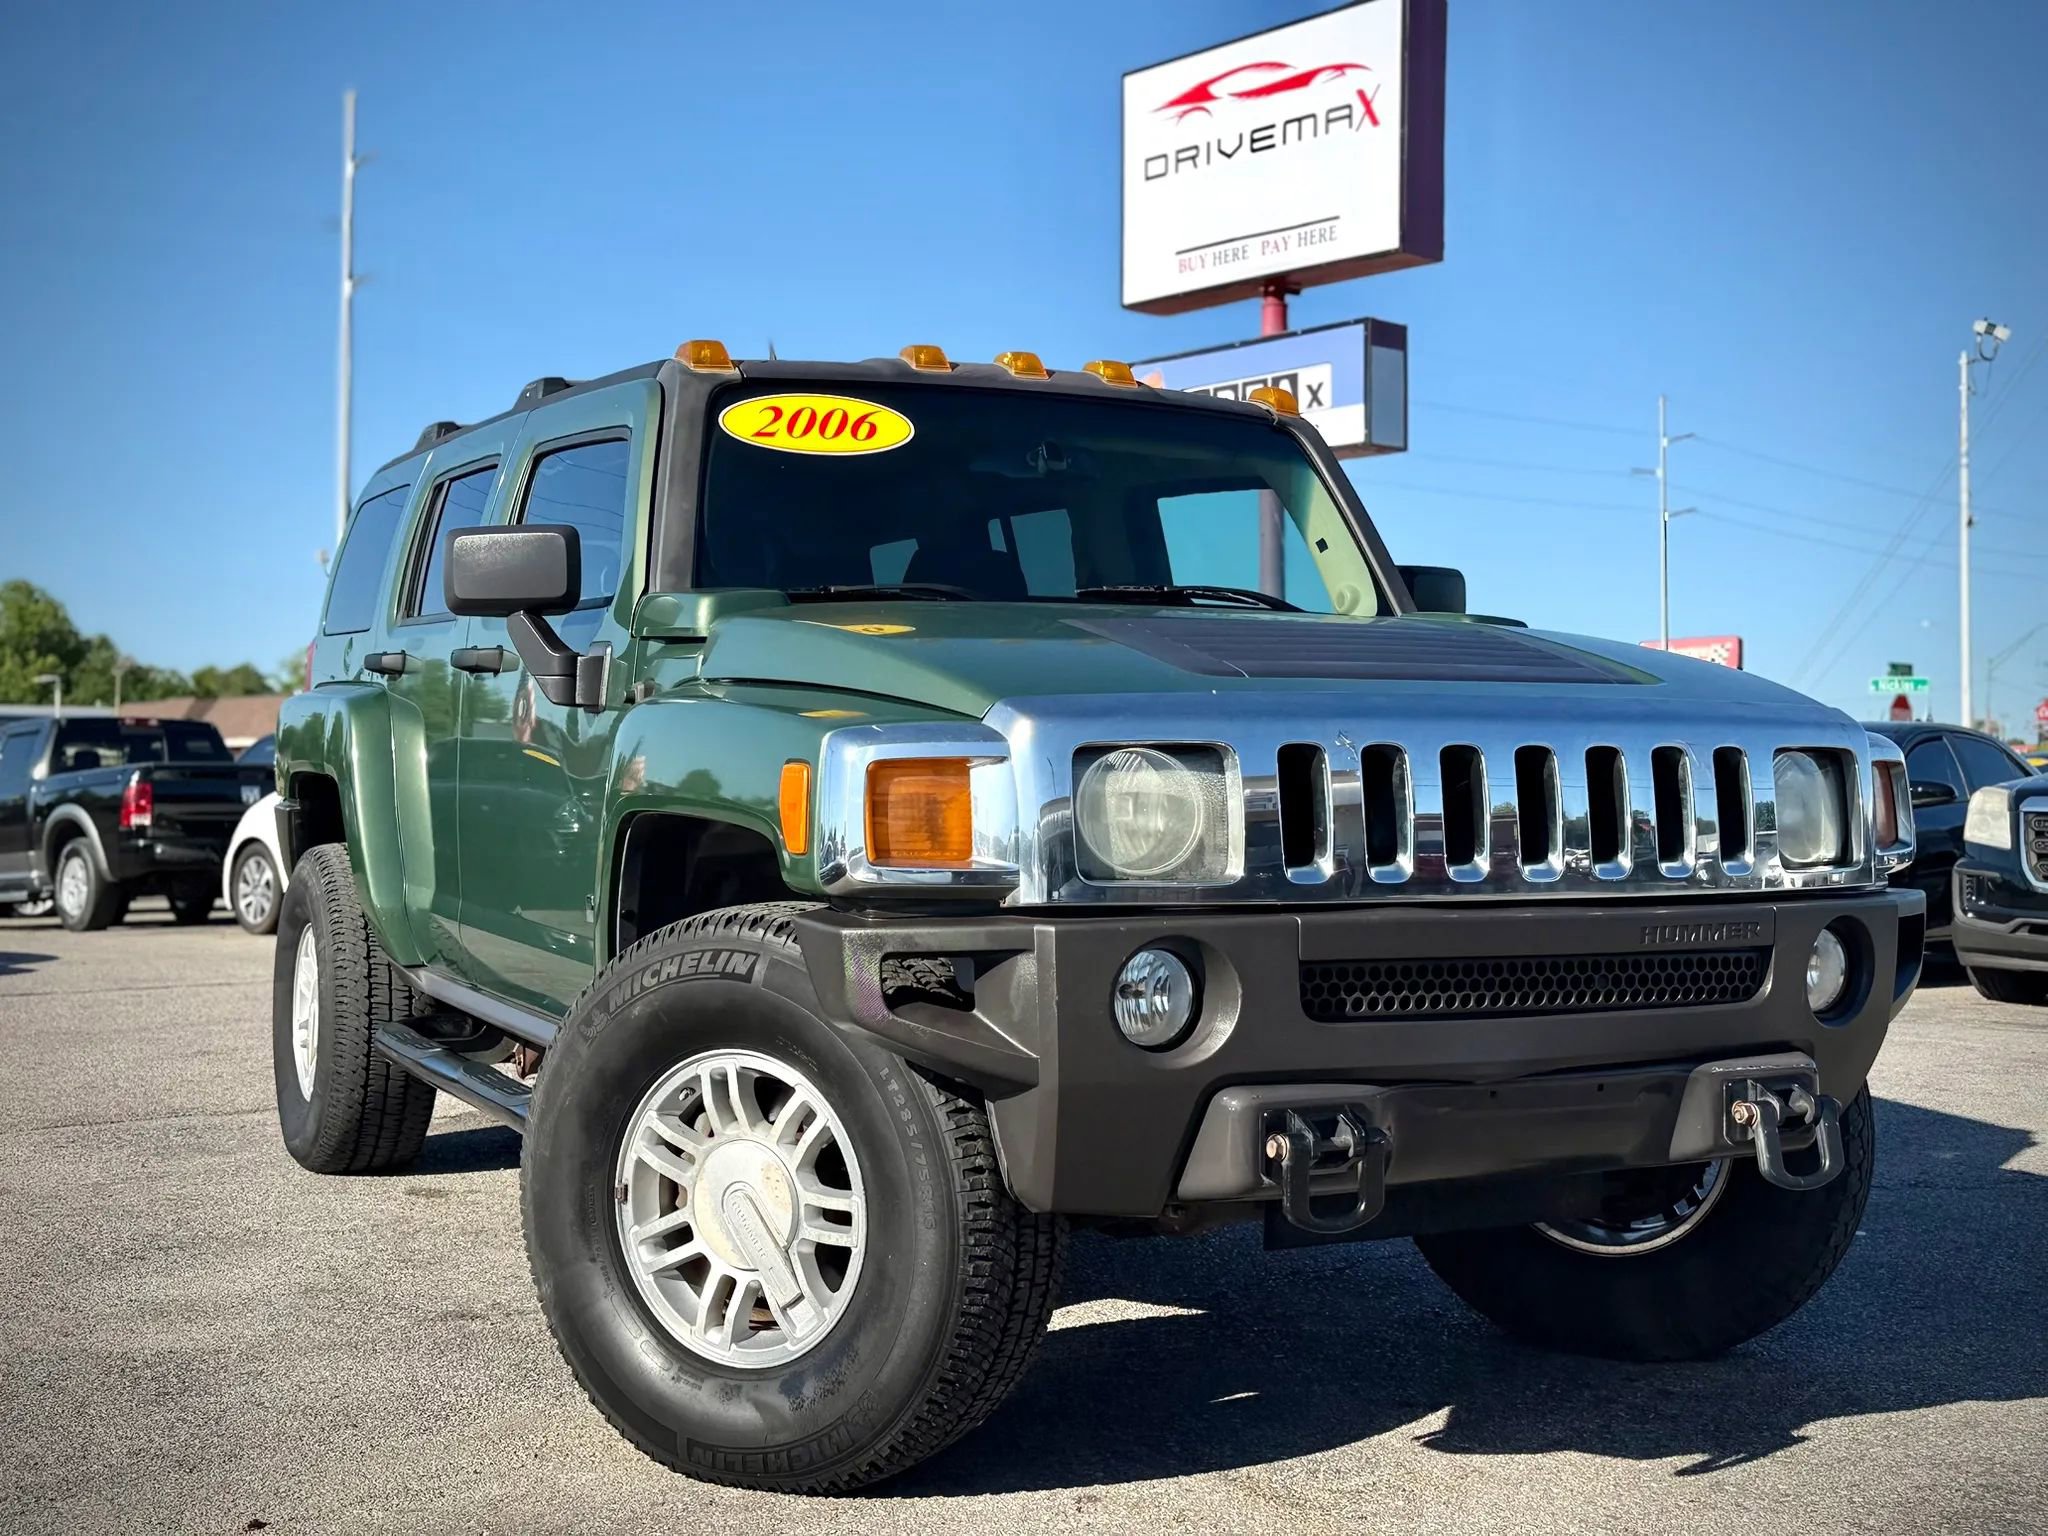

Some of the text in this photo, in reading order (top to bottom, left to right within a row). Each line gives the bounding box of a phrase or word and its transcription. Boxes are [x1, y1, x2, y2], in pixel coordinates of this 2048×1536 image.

[1144, 83, 1381, 182] DRIVEMAX
[1177, 224, 1337, 274] BUY HERE PAY HERE
[751, 405, 882, 442] 2006
[1640, 921, 1760, 945] HUMMER
[608, 951, 757, 1013] MICHELIN
